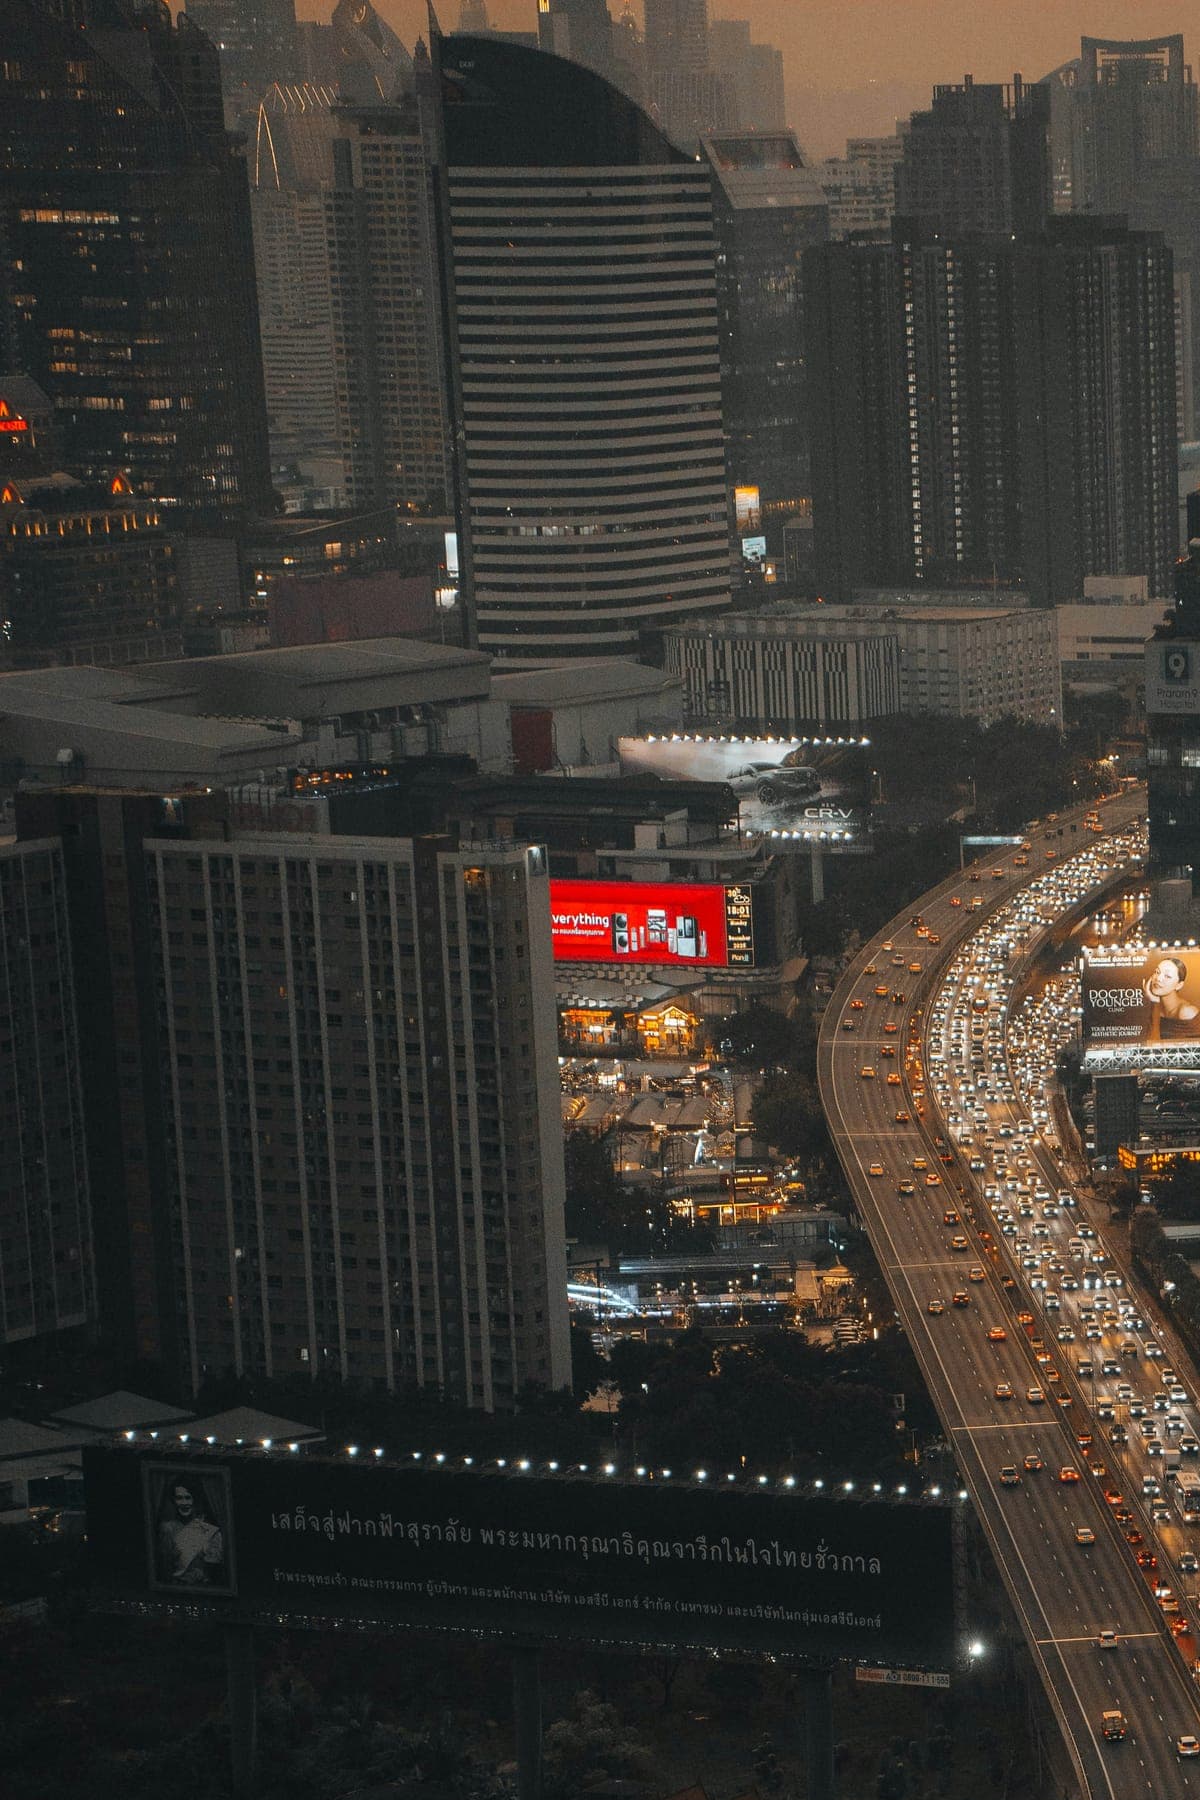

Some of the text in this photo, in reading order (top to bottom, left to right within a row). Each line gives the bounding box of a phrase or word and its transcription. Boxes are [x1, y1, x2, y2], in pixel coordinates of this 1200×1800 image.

[804, 807, 854, 819] CR-V
[1089, 989, 1144, 999] DOCTOR
[1090, 998, 1144, 1008] YOUNGER
[271, 1504, 881, 1574] เสด็จสู่ฟากฟ้าสุราลัย พระมหากรุณาธิคุณจารึกในใจไทยชั่วกาล
